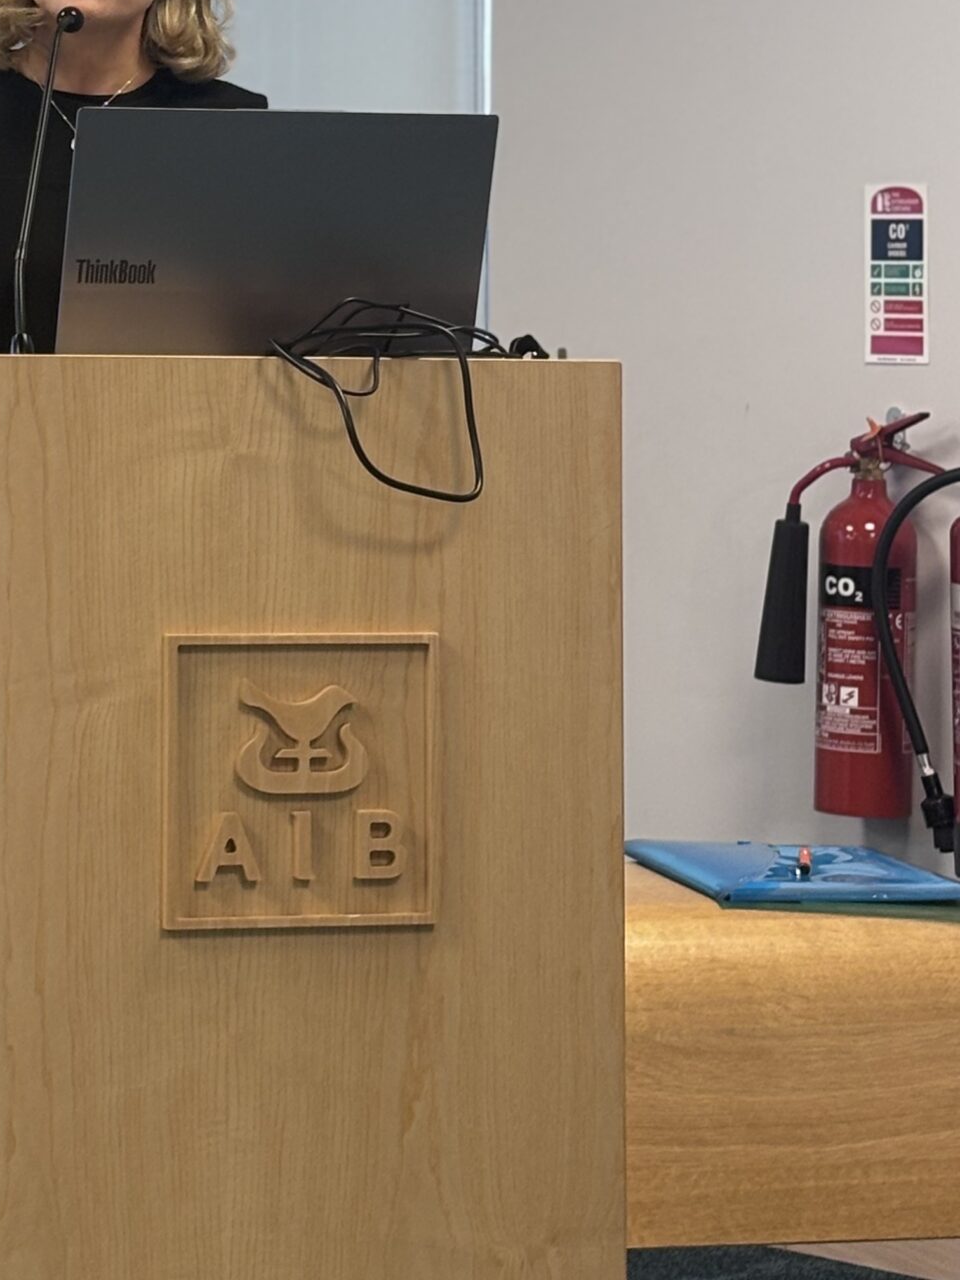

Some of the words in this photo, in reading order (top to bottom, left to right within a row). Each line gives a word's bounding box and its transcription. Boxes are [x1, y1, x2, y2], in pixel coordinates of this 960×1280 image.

[76, 259, 157, 284] ThinkBook
[825, 576, 863, 602] CO2
[194, 809, 407, 886] AIB
